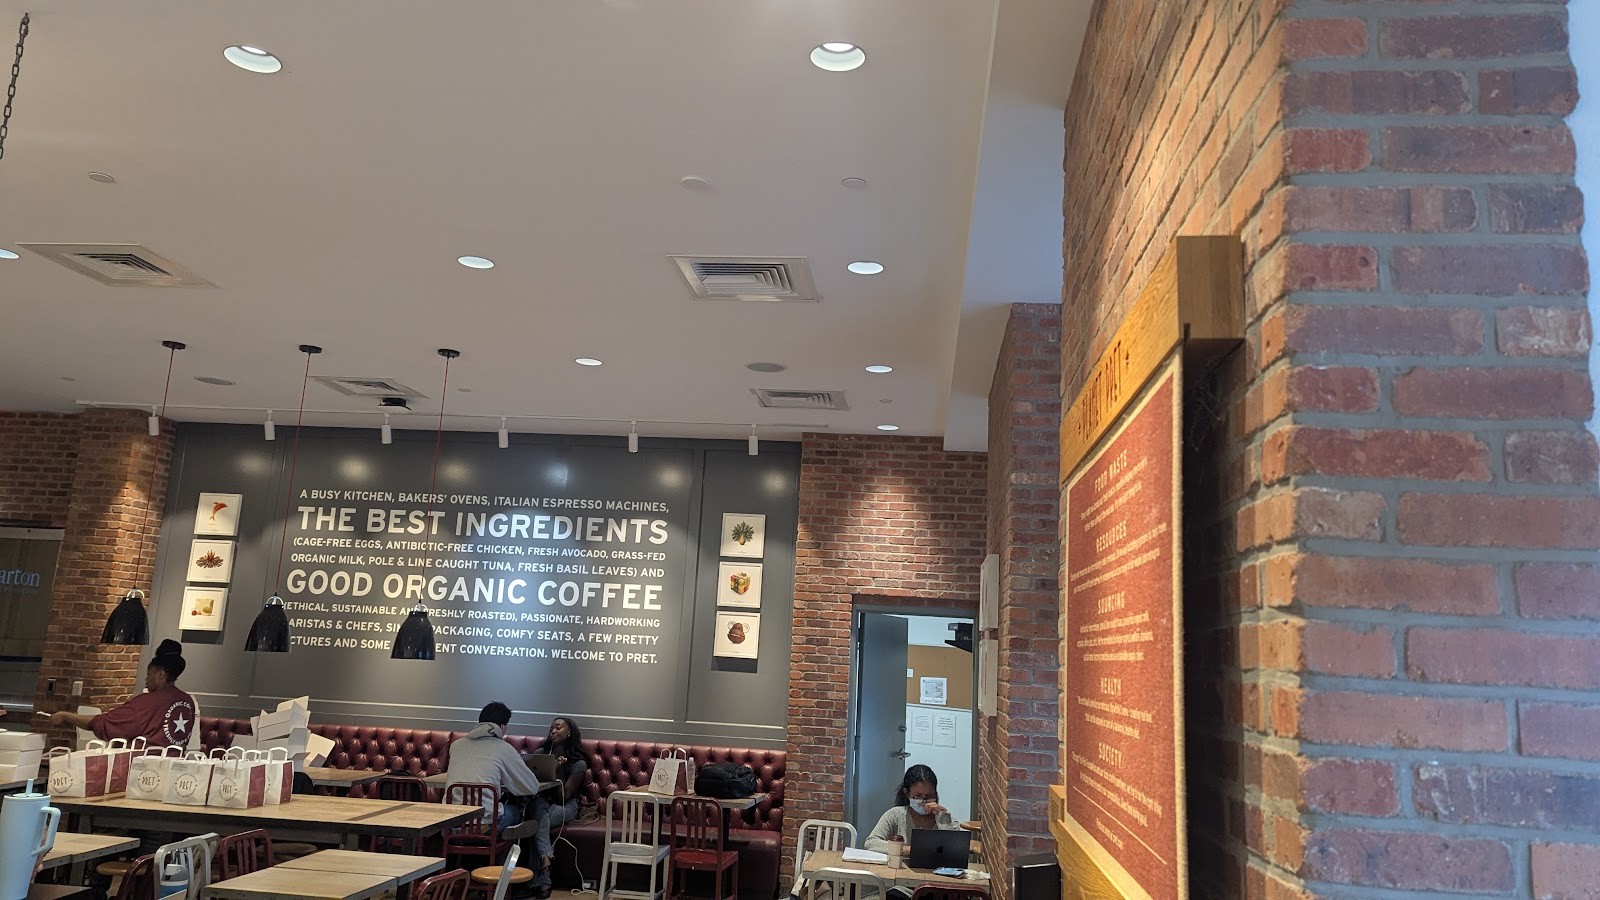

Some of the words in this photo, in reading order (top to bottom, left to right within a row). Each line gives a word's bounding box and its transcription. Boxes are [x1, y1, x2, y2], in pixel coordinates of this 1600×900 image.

[1105, 339, 1121, 413] PRET
[1094, 470, 1108, 494] FOOD
[1109, 449, 1127, 480] WASTE
[300, 489, 308, 499] A
[311, 490, 341, 500] BUSY
[343, 491, 395, 503] KITCHEN,
[398, 493, 447, 503] BAKERS'
[450, 495, 491, 506] OVENS,
[494, 496, 539, 507] ITALIAN
[543, 498, 602, 509] ESPRESSO
[606, 500, 669, 513] MACHINES,
[298, 506, 356, 531] THE
[367, 509, 445, 535] BEST
[455, 512, 668, 544] INGREDIENTS
[1096, 520, 1127, 552] RESOURCES
[293, 537, 352, 548] (CAGE-FREE
[355, 539, 384, 550] EGGS,
[386, 541, 474, 553] ANTIBIOTIC-FREE
[477, 544, 525, 556] CHICKEN,
[528, 547, 559, 557] FRESH
[561, 548, 608, 559] AVOCADO,
[611, 550, 666, 561] GRASS-FED
[0, 568, 40, 587] arton
[291, 553, 336, 564] ORGANIC
[338, 555, 365, 567] MILK,
[369, 556, 395, 566] POLE
[397, 557, 405, 566] &
[408, 558, 433, 568] LINE
[435, 559, 479, 570] CAUGHT
[482, 561, 515, 572] TUNA,
[518, 562, 553, 573] FRESH
[557, 564, 589, 575] BASIL
[592, 566, 637, 577] LEAVES)
[640, 568, 665, 578] AND
[286, 568, 373, 597] GOOD
[383, 573, 527, 604] ORGANIC
[538, 580, 663, 610] COFFEE
[283, 602, 329, 614] (ETHICAL,
[332, 604, 397, 615] SUSTAINABLE
[467, 610, 518, 622] ROASTED),
[521, 613, 583, 625] PASSIONATE,
[587, 616, 660, 628] HARDWORKING
[1098, 591, 1125, 614] SOURCING
[289, 618, 334, 630] ARISTAS
[336, 620, 343, 630] &
[346, 621, 383, 633] CHEFS,
[496, 629, 534, 641] COMFY
[537, 631, 575, 643] SEATS,
[577, 632, 586, 642] A
[589, 633, 612, 644] FEW
[615, 634, 659, 645] PRETTY
[290, 635, 331, 647] CTURES
[334, 638, 357, 648] AND
[360, 638, 391, 650] SOME
[460, 644, 548, 659] CONVERSATION.
[551, 649, 605, 661] WELCOME
[609, 652, 623, 662] TO
[626, 653, 658, 664] PRET.
[1101, 678, 1121, 696] HEALTH
[1099, 742, 1122, 769] SOCIETY
[53, 776, 67, 787] PRET
[141, 776, 155, 786] PRET
